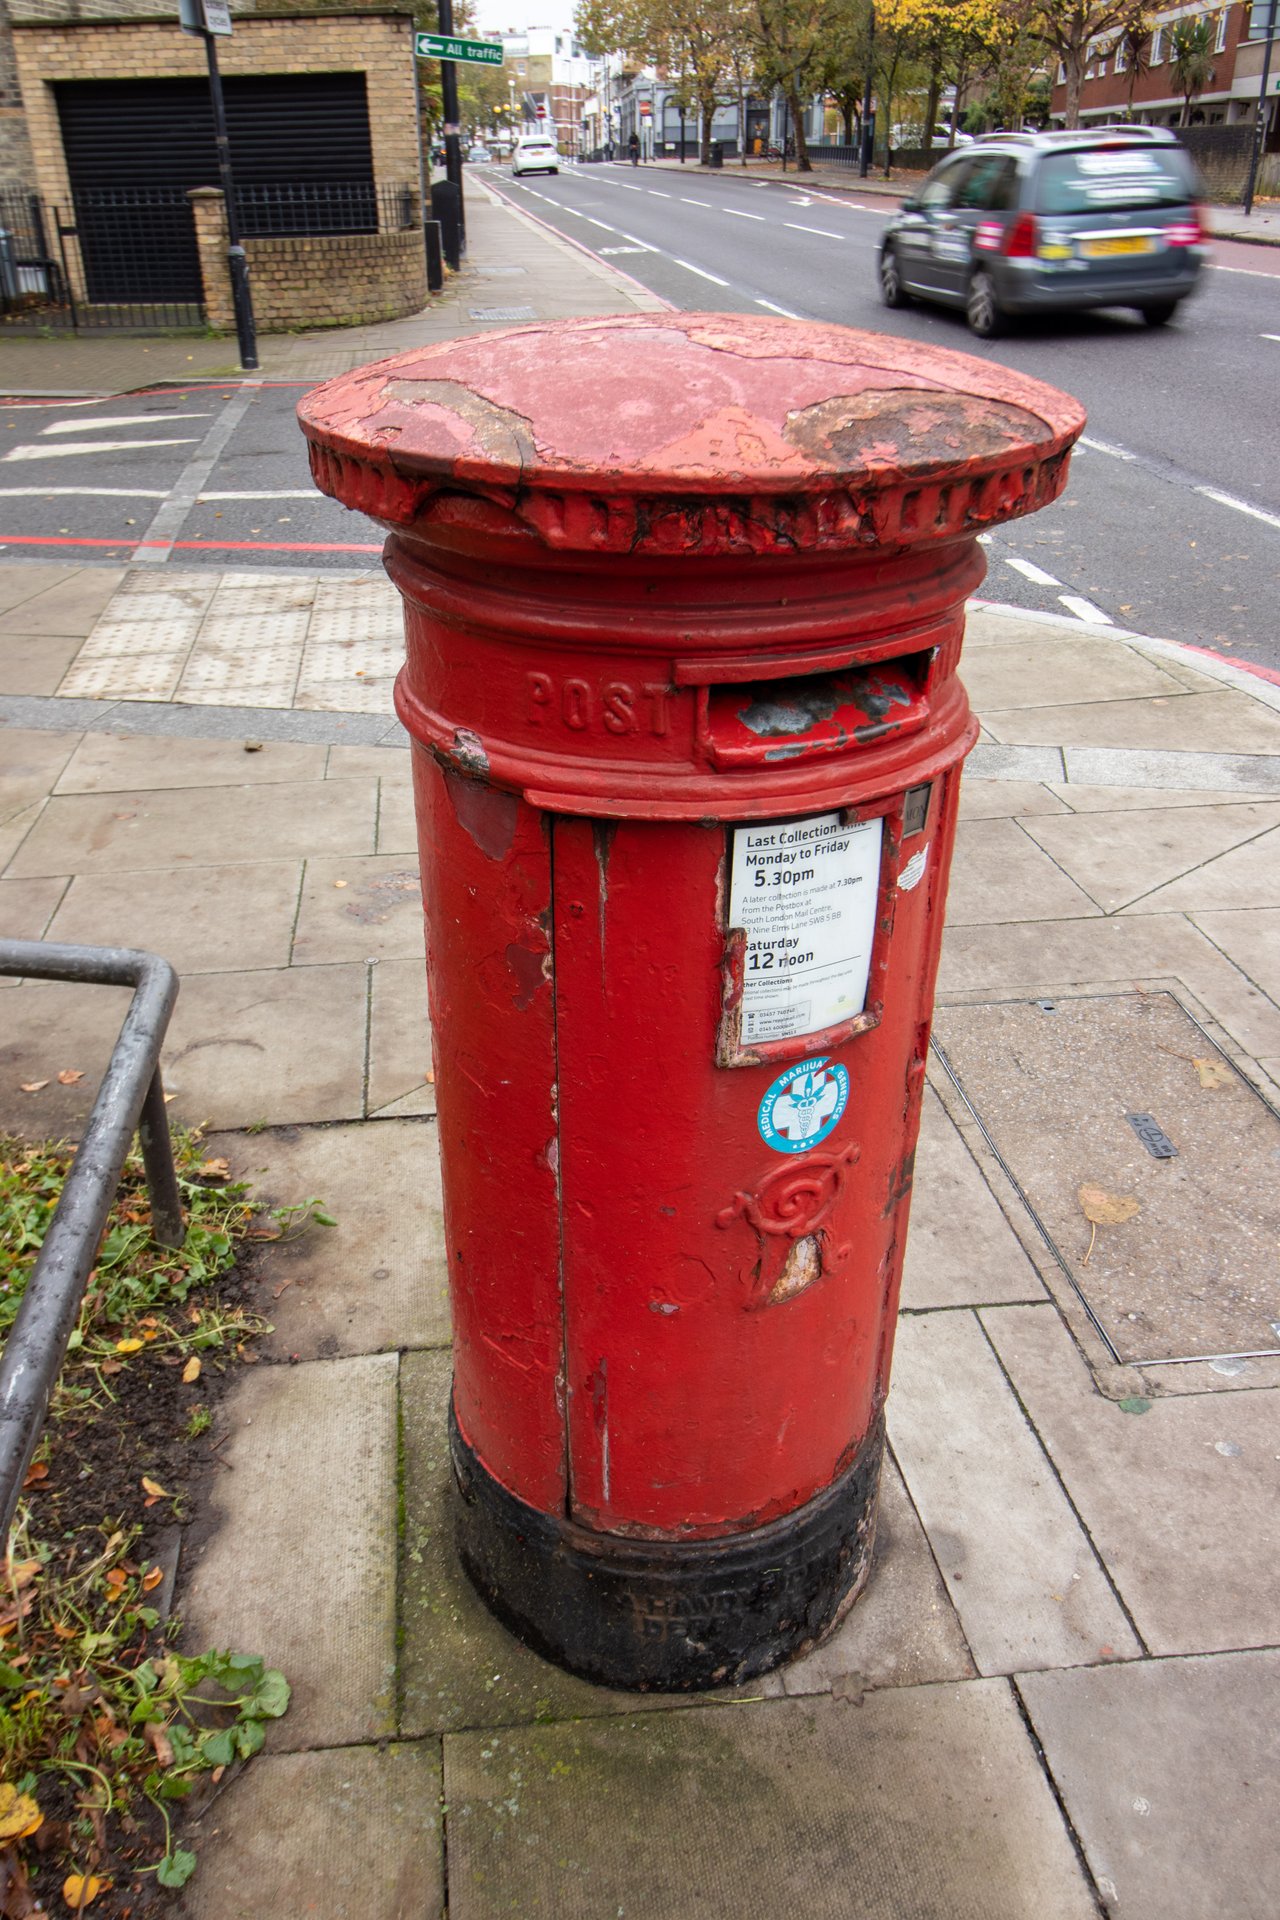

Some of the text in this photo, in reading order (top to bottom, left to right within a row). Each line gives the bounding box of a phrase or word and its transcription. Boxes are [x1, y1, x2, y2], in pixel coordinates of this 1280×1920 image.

[446, 43, 502, 61] All traffic
[527, 671, 670, 737] POST
[747, 835, 776, 848] Last
[780, 825, 837, 844] Collection
[746, 840, 850, 867] Monday to Friday
[754, 869, 814, 888] 5.30pm
[742, 896, 748, 904] A
[749, 895, 767, 904] later
[768, 890, 802, 901] collection
[803, 888, 808, 896] is
[809, 885, 828, 894] made
[836, 876, 863, 888] 7.30pm
[742, 898, 812, 914] from the Postbox at
[741, 916, 764, 925] South
[765, 912, 793, 923] London
[794, 908, 809, 918] Mail
[752, 925, 770, 934] Nine
[771, 923, 790, 932] Elms
[791, 920, 808, 930] Lane
[809, 916, 825, 926] SW8
[749, 951, 814, 970] 12 noon
[761, 1060, 848, 1139] MEDICAL MARIJUAA GENETICS
